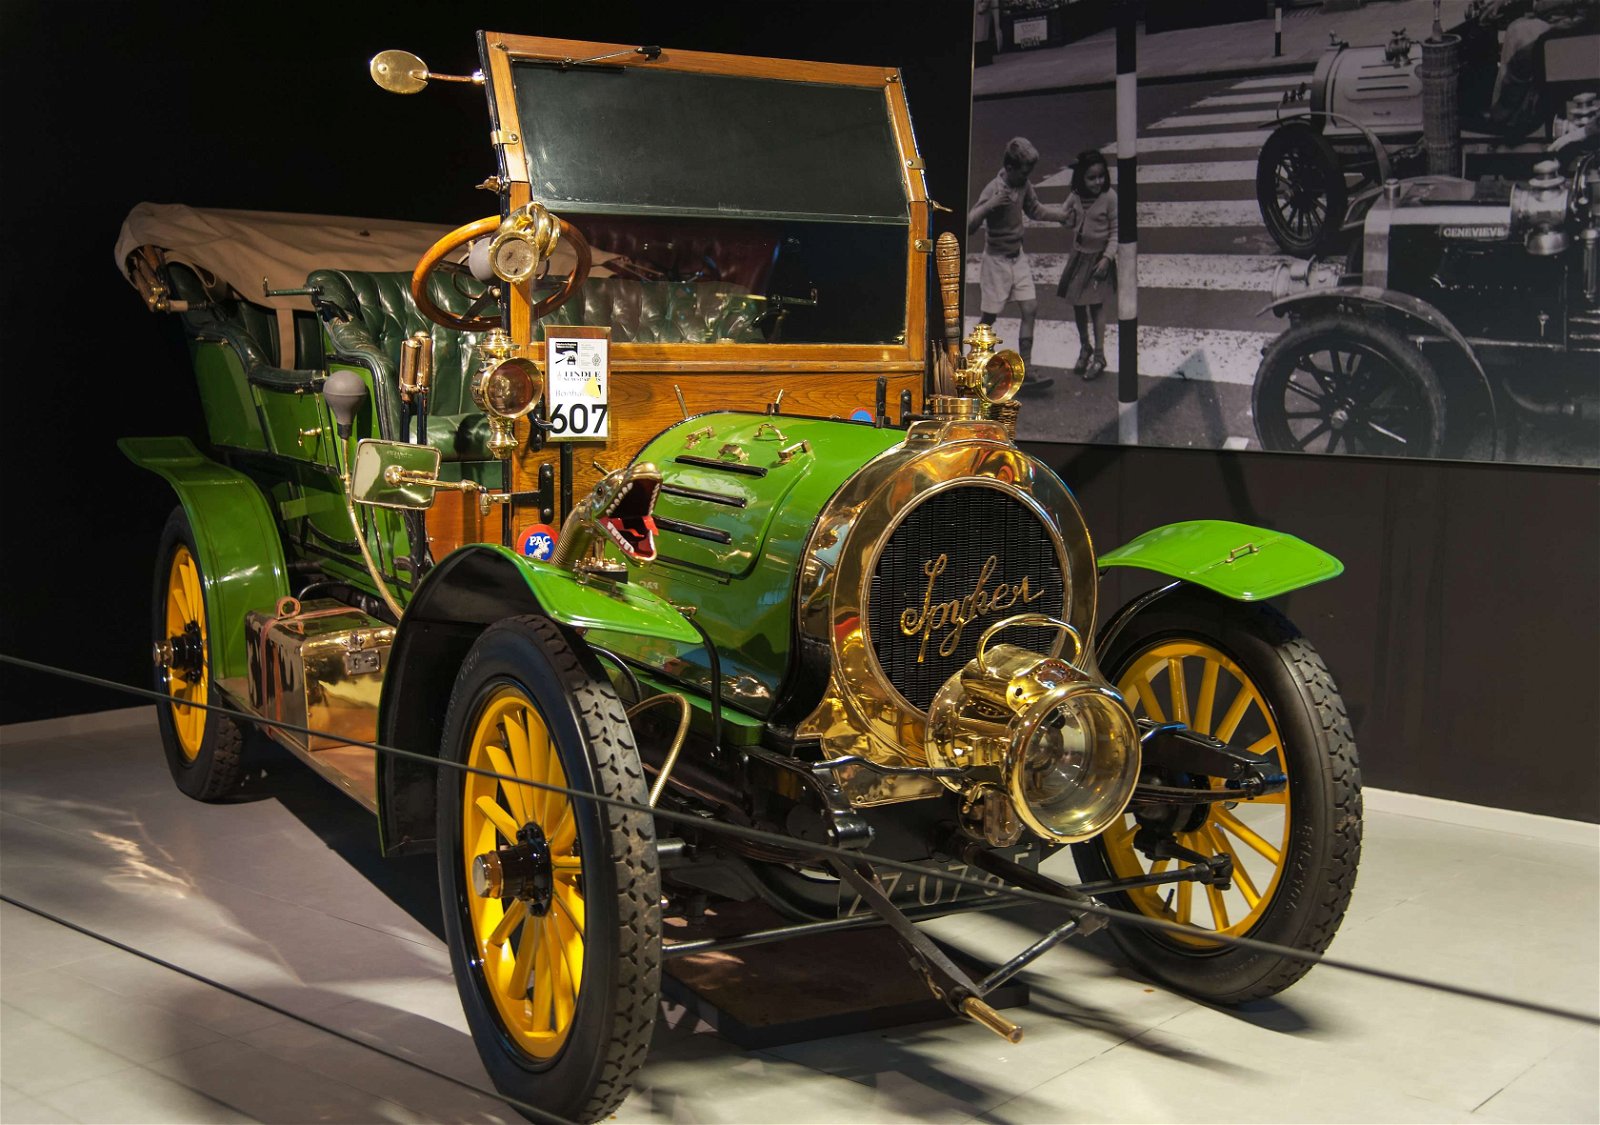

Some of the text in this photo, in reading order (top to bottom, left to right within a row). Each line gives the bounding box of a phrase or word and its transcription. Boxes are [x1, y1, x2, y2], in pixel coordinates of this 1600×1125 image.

[1442, 226, 1506, 238] GENEVIEVE
[550, 403, 608, 434] 607
[901, 553, 1045, 663] Spyker
